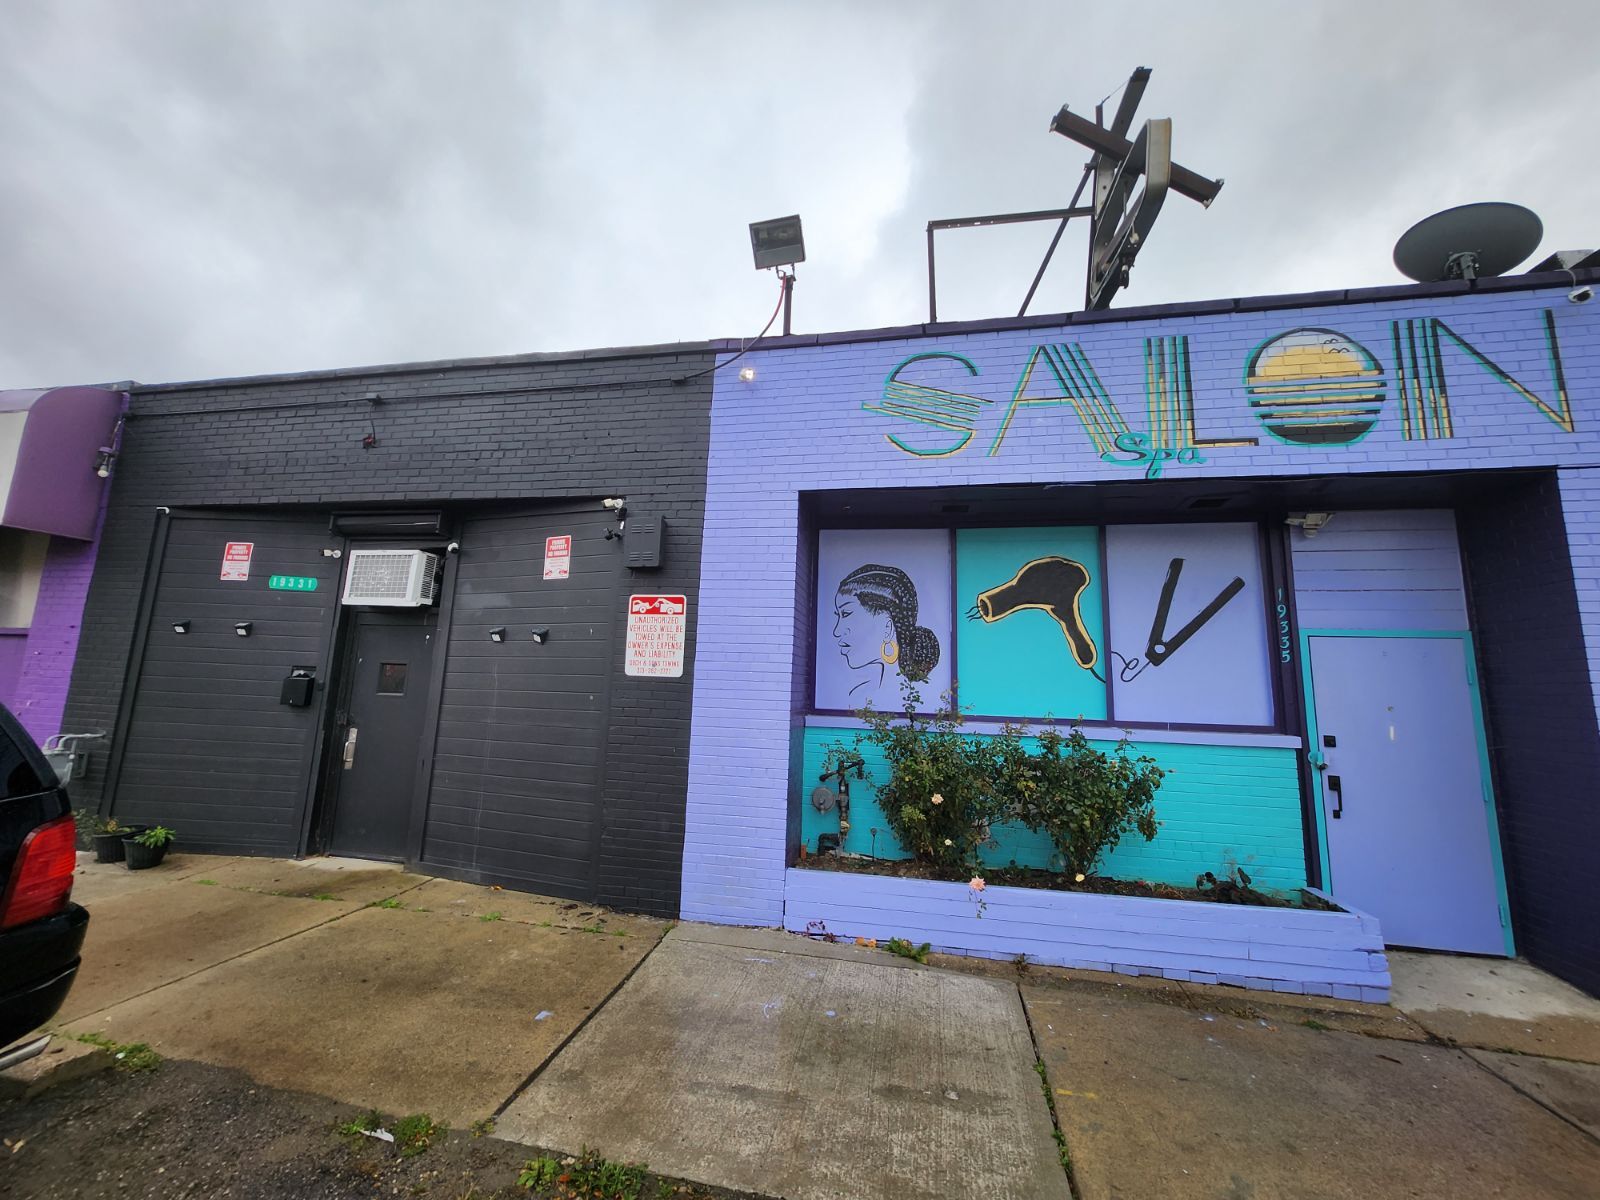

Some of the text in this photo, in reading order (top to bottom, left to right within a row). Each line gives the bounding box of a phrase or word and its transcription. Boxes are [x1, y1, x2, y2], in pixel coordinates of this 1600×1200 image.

[862, 308, 1576, 459] SALON
[1100, 432, 1208, 480] Spa
[273, 577, 313, 589] 19331
[634, 616, 679, 624] UNAUTHORIZED
[1277, 587, 1291, 663] 19335
[629, 624, 683, 633] VEHICLES WILL BE
[635, 633, 678, 642] TOWED AT THE
[628, 641, 683, 651] OWNER'S EXPENSE
[633, 649, 676, 659] AND LIABILITY
